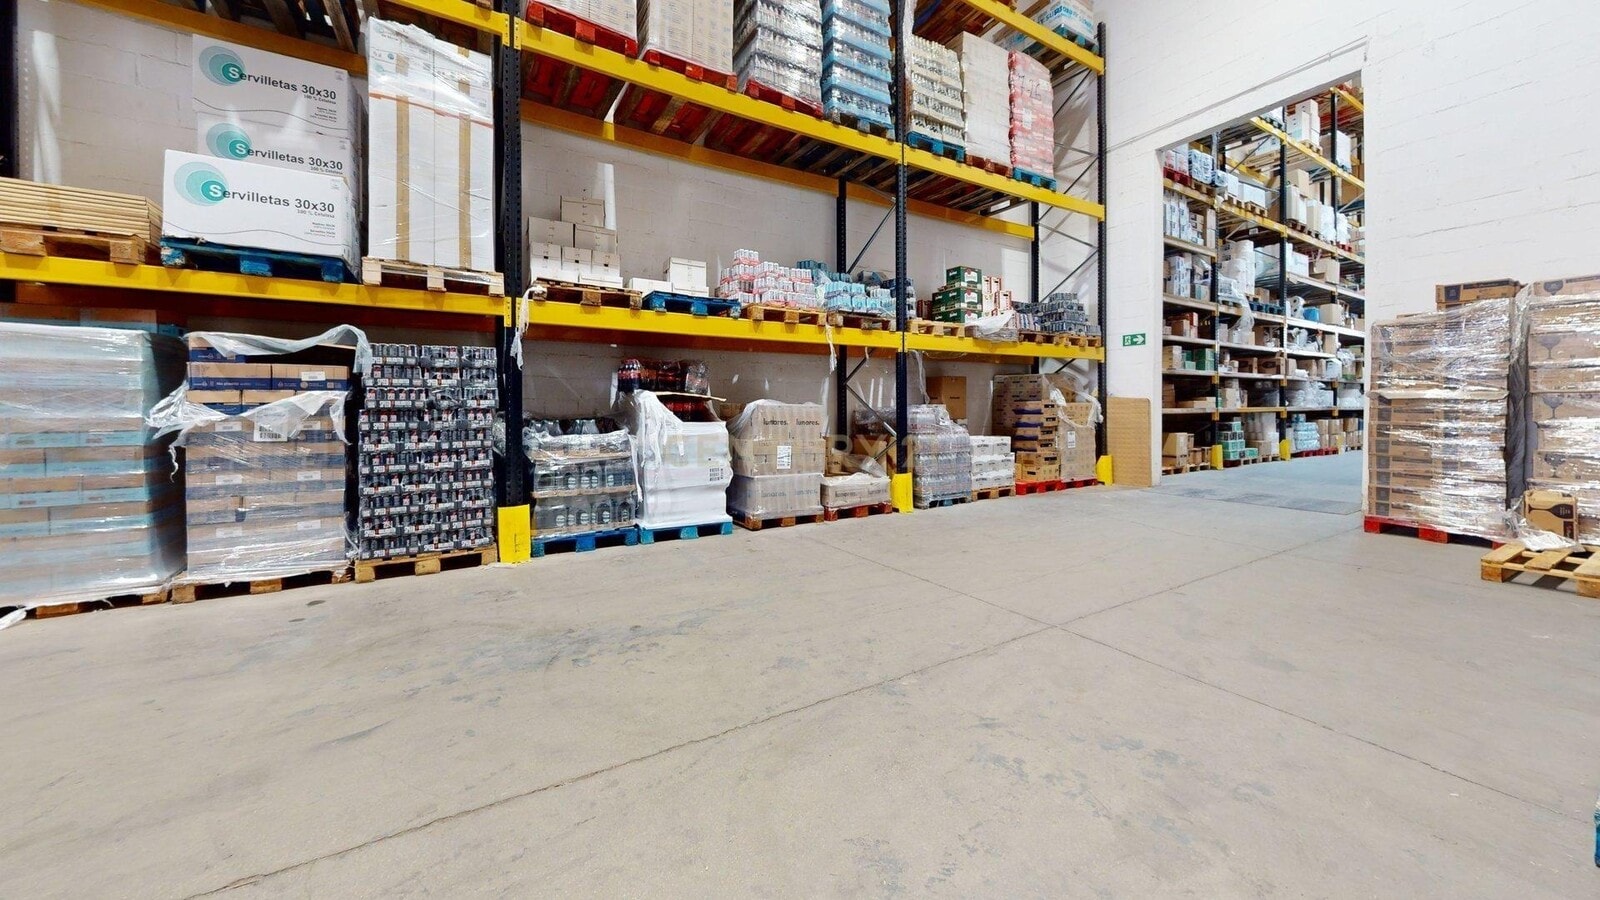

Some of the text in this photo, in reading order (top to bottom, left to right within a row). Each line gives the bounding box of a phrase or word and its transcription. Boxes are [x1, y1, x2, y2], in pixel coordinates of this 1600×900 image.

[228, 66, 336, 100] Servilletas 30x30
[235, 142, 343, 170] Servilletas 30x30
[208, 184, 334, 213] Servilletas 30x30
